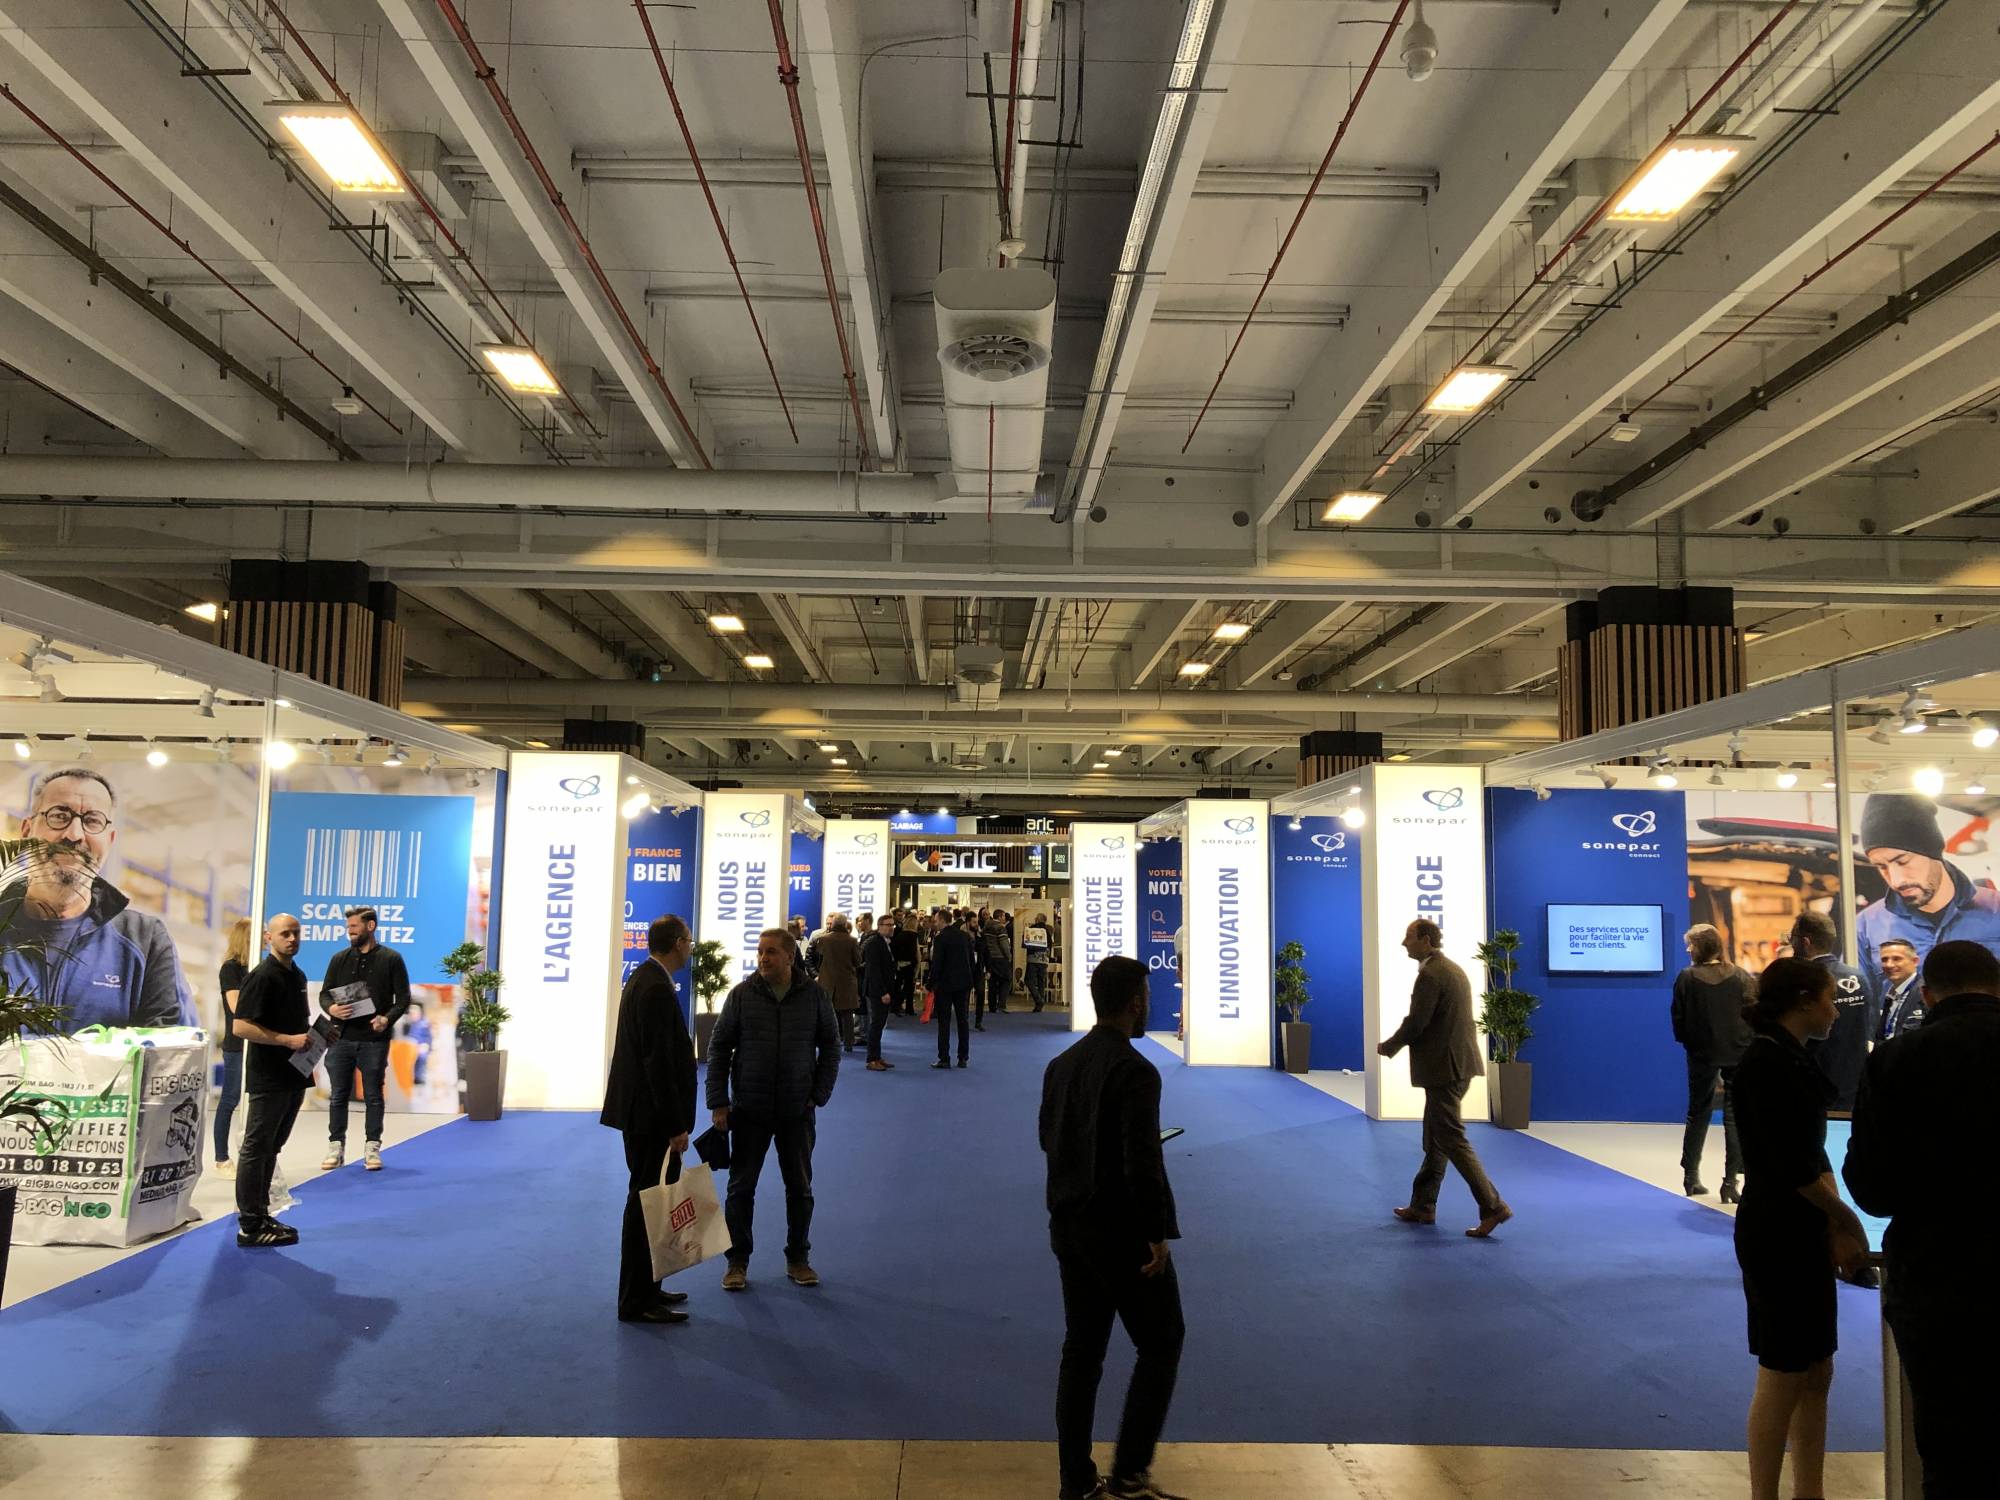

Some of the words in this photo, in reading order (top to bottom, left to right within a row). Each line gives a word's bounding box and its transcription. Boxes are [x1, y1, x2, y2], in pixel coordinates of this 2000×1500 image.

[528, 805, 604, 814] sonepar
[1026, 817, 1055, 832] aric
[1392, 817, 1467, 826] sonepar
[634, 848, 682, 858] FRANCE
[1582, 841, 1661, 852] sonepar
[939, 850, 997, 870] aric
[1286, 855, 1348, 863] sonepar
[633, 863, 682, 882] BIEN
[1148, 869, 1177, 877] VOTRE
[717, 861, 739, 921] NOUS
[302, 903, 405, 922] SCAEZ
[543, 845, 576, 982] L'AGENCE
[300, 924, 415, 943] EMPTEZ
[636, 931, 646, 940] LA
[1569, 925, 1585, 933] Des
[1621, 926, 1649, 935] conçus
[1569, 934, 1589, 942] pour
[1590, 932, 1621, 940] faciliter
[1218, 868, 1240, 1019] L'INNOVATION
[1569, 941, 1580, 949] de
[1598, 941, 1627, 949] clients.
[151, 1076, 179, 1095] BIG
[180, 1073, 204, 1092] BAG
[0, 1157, 16, 1171] 01
[23, 1158, 44, 1172] 80
[52, 1159, 69, 1173] 18
[77, 1160, 96, 1174] 19
[101, 1162, 121, 1175] 53
[25, 1198, 62, 1216] BAG
